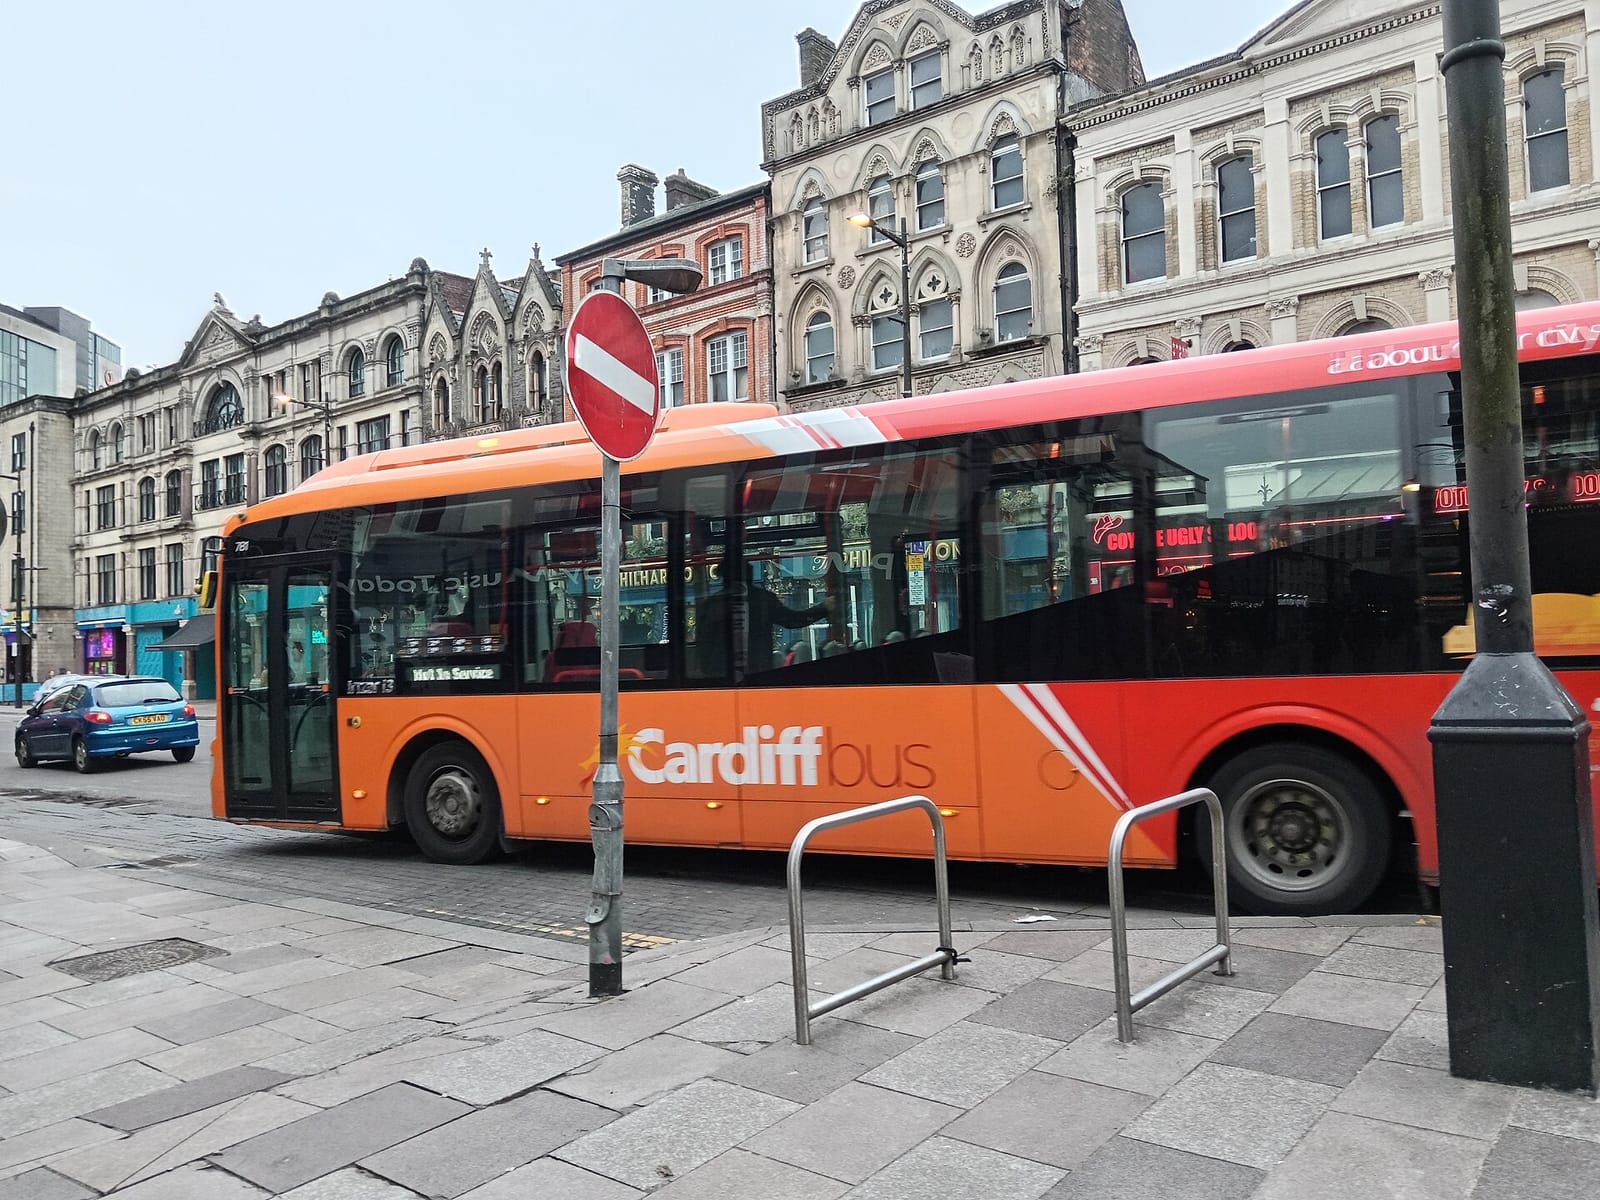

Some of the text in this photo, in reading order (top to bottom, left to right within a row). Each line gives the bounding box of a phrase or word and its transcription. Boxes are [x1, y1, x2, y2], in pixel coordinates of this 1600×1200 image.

[1166, 525, 1204, 546] UGLY
[451, 666, 495, 680] Service
[628, 724, 937, 789] Cardiff bus
